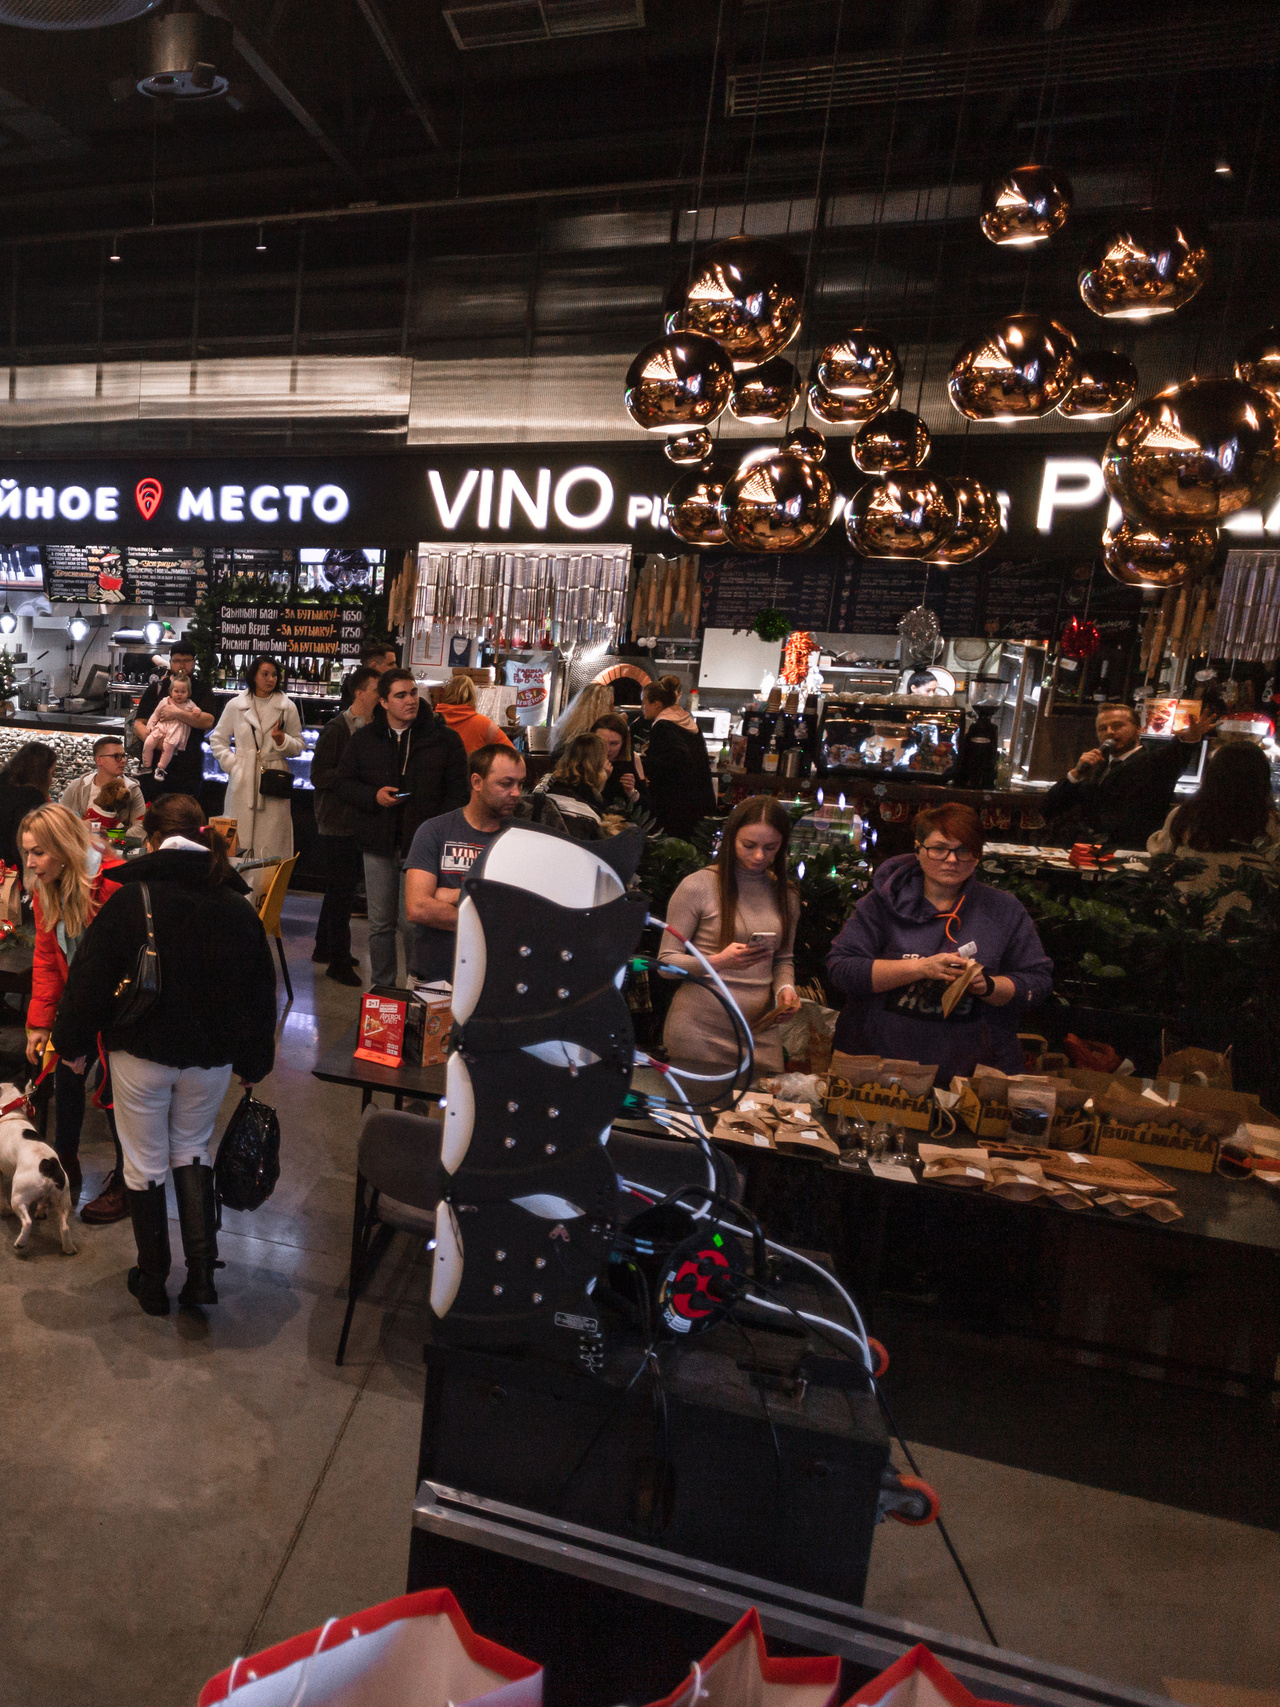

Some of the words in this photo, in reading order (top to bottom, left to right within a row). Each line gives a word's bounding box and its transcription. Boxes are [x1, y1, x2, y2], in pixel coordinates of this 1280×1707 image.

[177, 483, 350, 524] МЕСТО
[427, 464, 615, 530] VINO
[343, 610, 362, 622] 1650
[379, 1013, 402, 1021] APEROL
[831, 1085, 930, 1114] BULLMAFIA
[1101, 1125, 1214, 1154] BULLMAFIA
